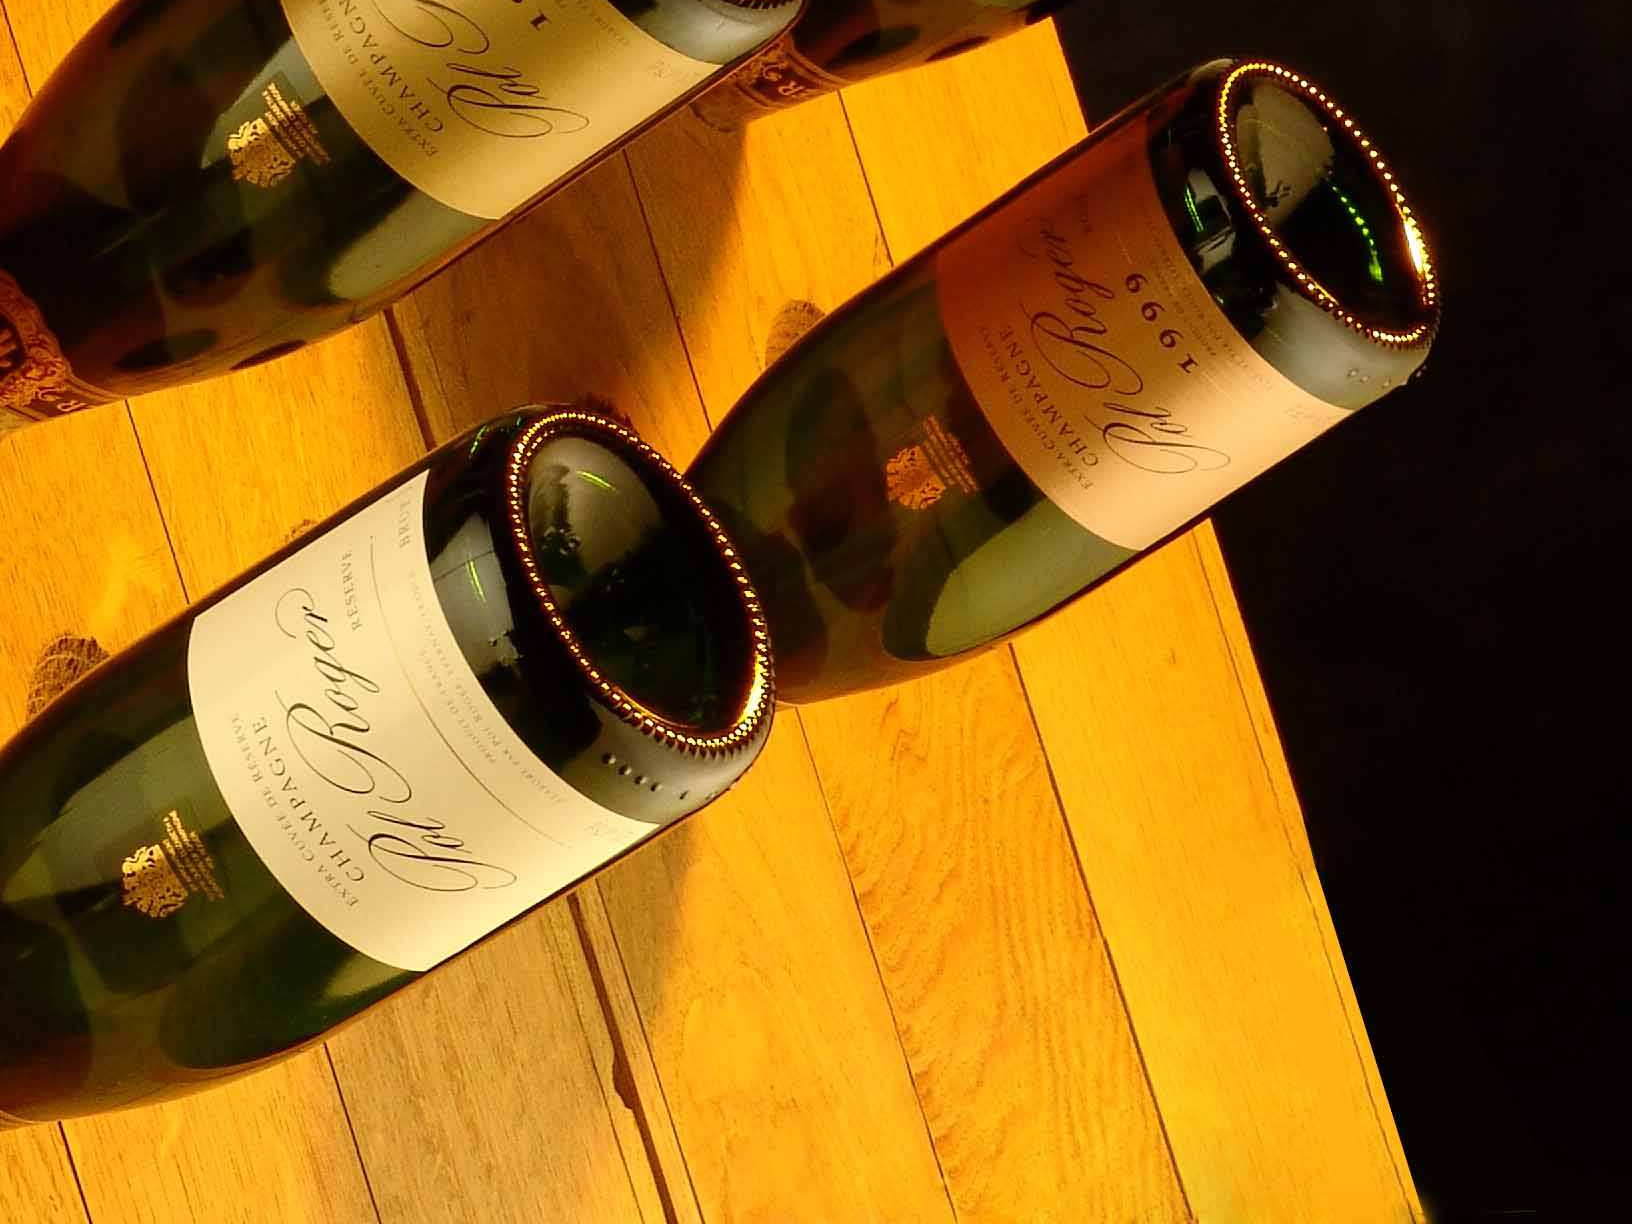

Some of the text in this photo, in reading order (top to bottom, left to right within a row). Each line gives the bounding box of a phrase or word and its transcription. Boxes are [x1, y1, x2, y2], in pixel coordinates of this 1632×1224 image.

[424, 60, 590, 138] Pol
[1016, 222, 1142, 393] Roger
[1122, 269, 1199, 374] 1999
[998, 324, 1100, 468] CHAMPAGNE
[1082, 400, 1231, 475] Pol
[396, 498, 413, 548] BRUT
[272, 589, 517, 896] Pol Roger
[249, 715, 366, 884] CHAMPAGNE
[258, 786, 278, 808] DE
